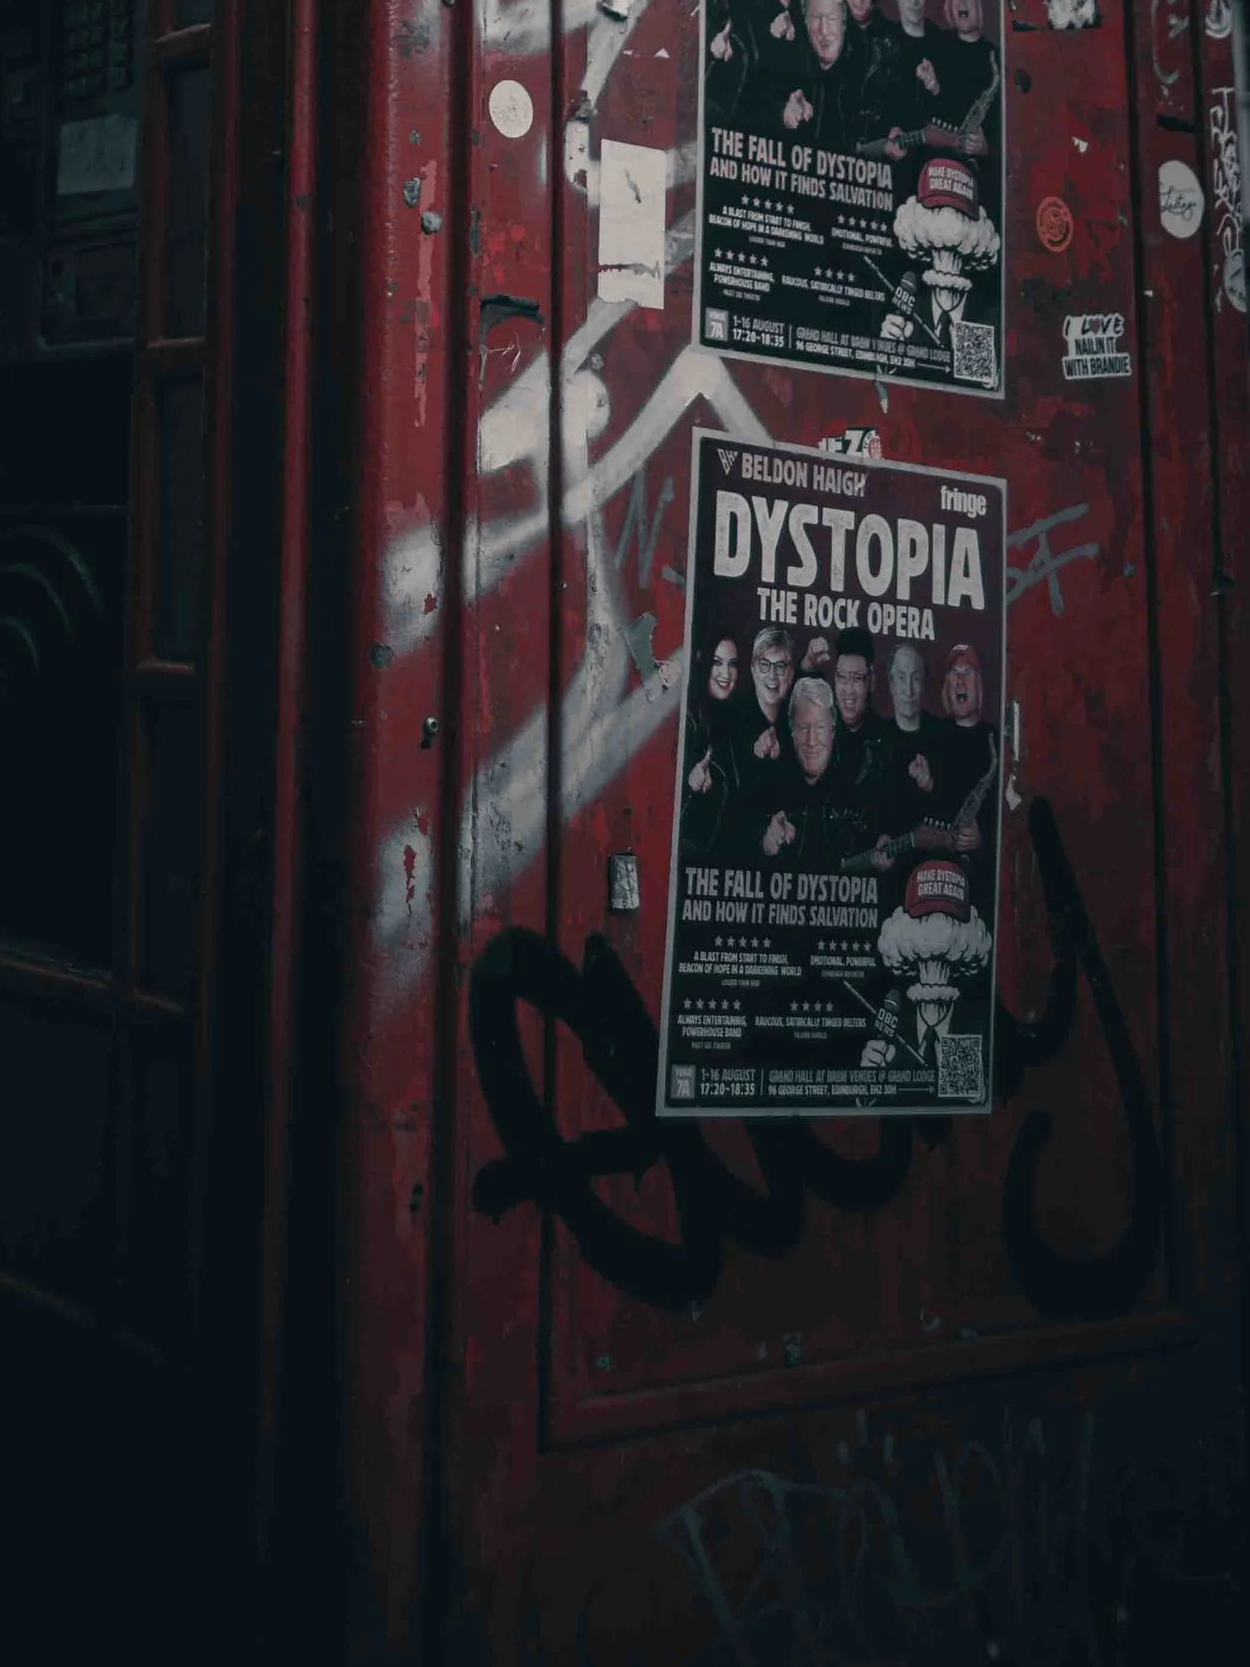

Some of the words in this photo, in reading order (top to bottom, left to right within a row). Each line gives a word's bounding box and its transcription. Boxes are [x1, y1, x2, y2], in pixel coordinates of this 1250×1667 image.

[711, 126, 744, 158] THE
[748, 134, 786, 167] FALL
[791, 144, 812, 172] OF
[816, 149, 893, 190] DYSTOPIA
[710, 157, 738, 180] AND
[742, 162, 772, 187] HOW
[775, 169, 787, 191] IT
[790, 173, 826, 199] FINDS
[829, 181, 893, 212] SALVATION
[710, 322, 725, 339] 7A
[752, 318, 785, 334] AUGUST
[732, 328, 784, 348] 17:20-18:35
[1065, 358, 1088, 376] WITH
[1090, 356, 1130, 375] BRANDIE
[741, 452, 808, 489] BELDON
[813, 465, 868, 497] HAIGH
[941, 485, 987, 518] fringe
[713, 489, 985, 611] DYSTOPIA
[757, 587, 797, 624] THE
[804, 593, 861, 630] ROCK
[867, 602, 935, 641] OPERA
[917, 869, 935, 881] MAKE
[686, 866, 719, 896] THE
[724, 868, 764, 899] FALL
[770, 872, 793, 900] OF
[797, 873, 878, 904] DYSTOPIA
[918, 881, 942, 896] GREAT
[682, 899, 712, 922] AND
[715, 901, 749, 923] HOW
[751, 902, 765, 924] IT
[769, 903, 806, 925] FINDS
[809, 905, 878, 928] SALVATION
[700, 951, 719, 962] BLAST
[739, 953, 757, 964] START
[678, 962, 703, 973] BEACON
[704, 963, 713, 974] OF
[714, 963, 730, 974] HOPE
[780, 966, 802, 977] WORLD
[677, 1014, 702, 1025] ALWAYS
[682, 1026, 724, 1037] POWERHOUSE
[725, 1027, 742, 1037] BAND
[702, 1068, 719, 1081] 1-16
[721, 1068, 756, 1081] AUGUST
[769, 1069, 794, 1083] GRAND
[795, 1070, 813, 1083] HALL
[815, 1070, 825, 1082] AT
[913, 1070, 935, 1083] LODGE
[677, 1079, 690, 1095] 7A
[700, 1083, 755, 1095] 17:20-18:35
[778, 1084, 803, 1095] GEORGE
